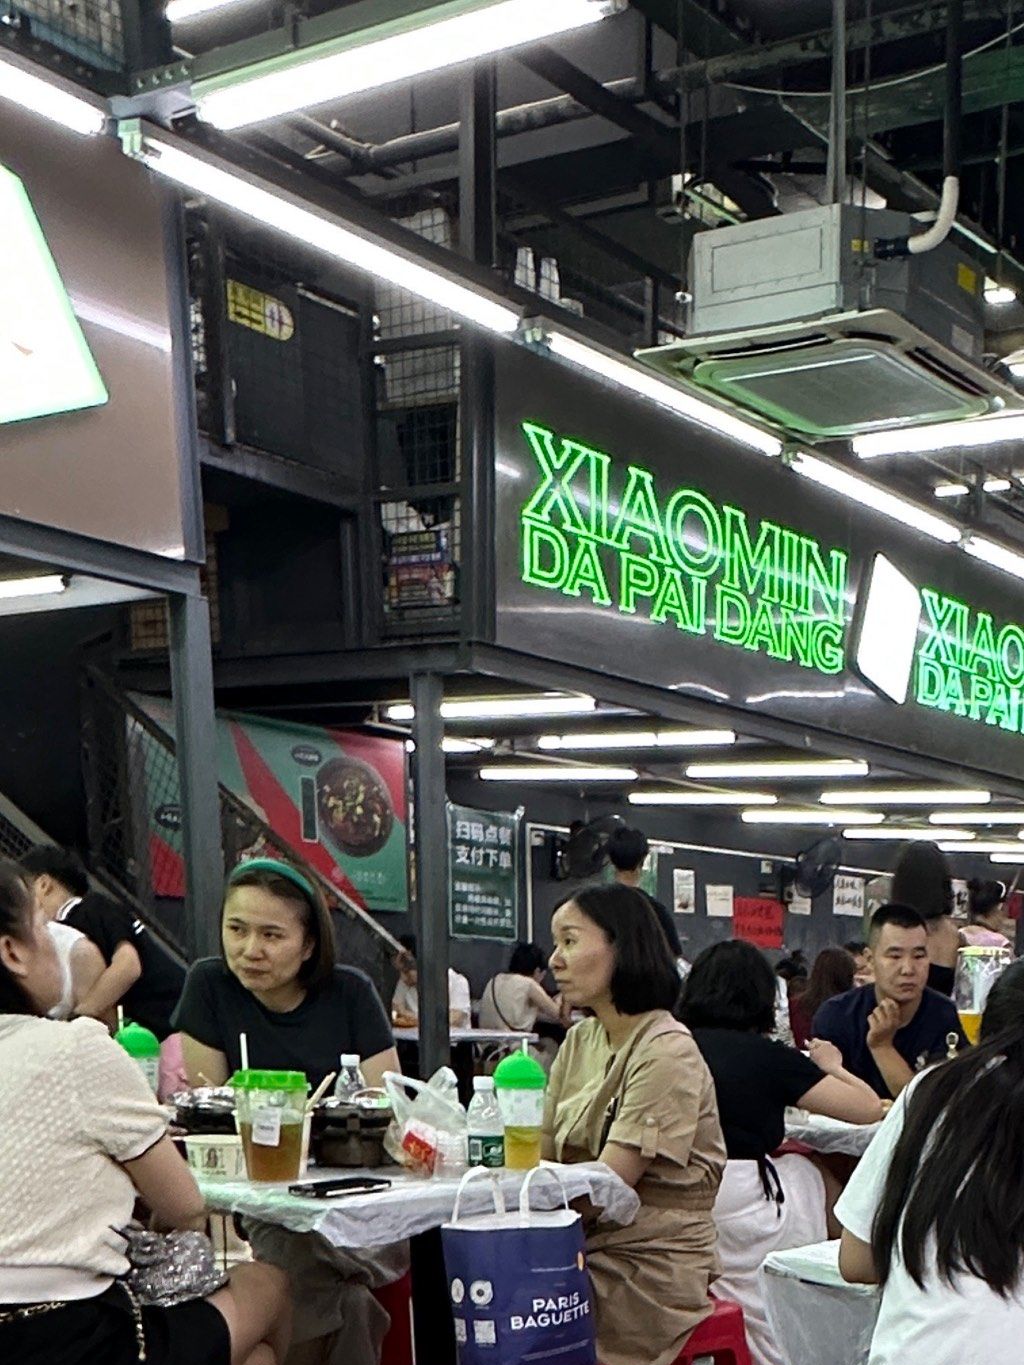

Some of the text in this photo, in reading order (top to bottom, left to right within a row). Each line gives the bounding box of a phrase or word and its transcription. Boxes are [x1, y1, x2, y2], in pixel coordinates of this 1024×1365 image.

[522, 421, 848, 624] XIAOMIN
[521, 513, 611, 608] DA
[618, 554, 707, 635] PAI
[713, 591, 845, 675] DANG
[917, 657, 967, 715] DA
[970, 673, 1020, 732] PAI
[456, 844, 512, 868] 支付下单
[510, 1300, 590, 1331] BAGUETTE
[532, 1291, 580, 1313] PARIS
